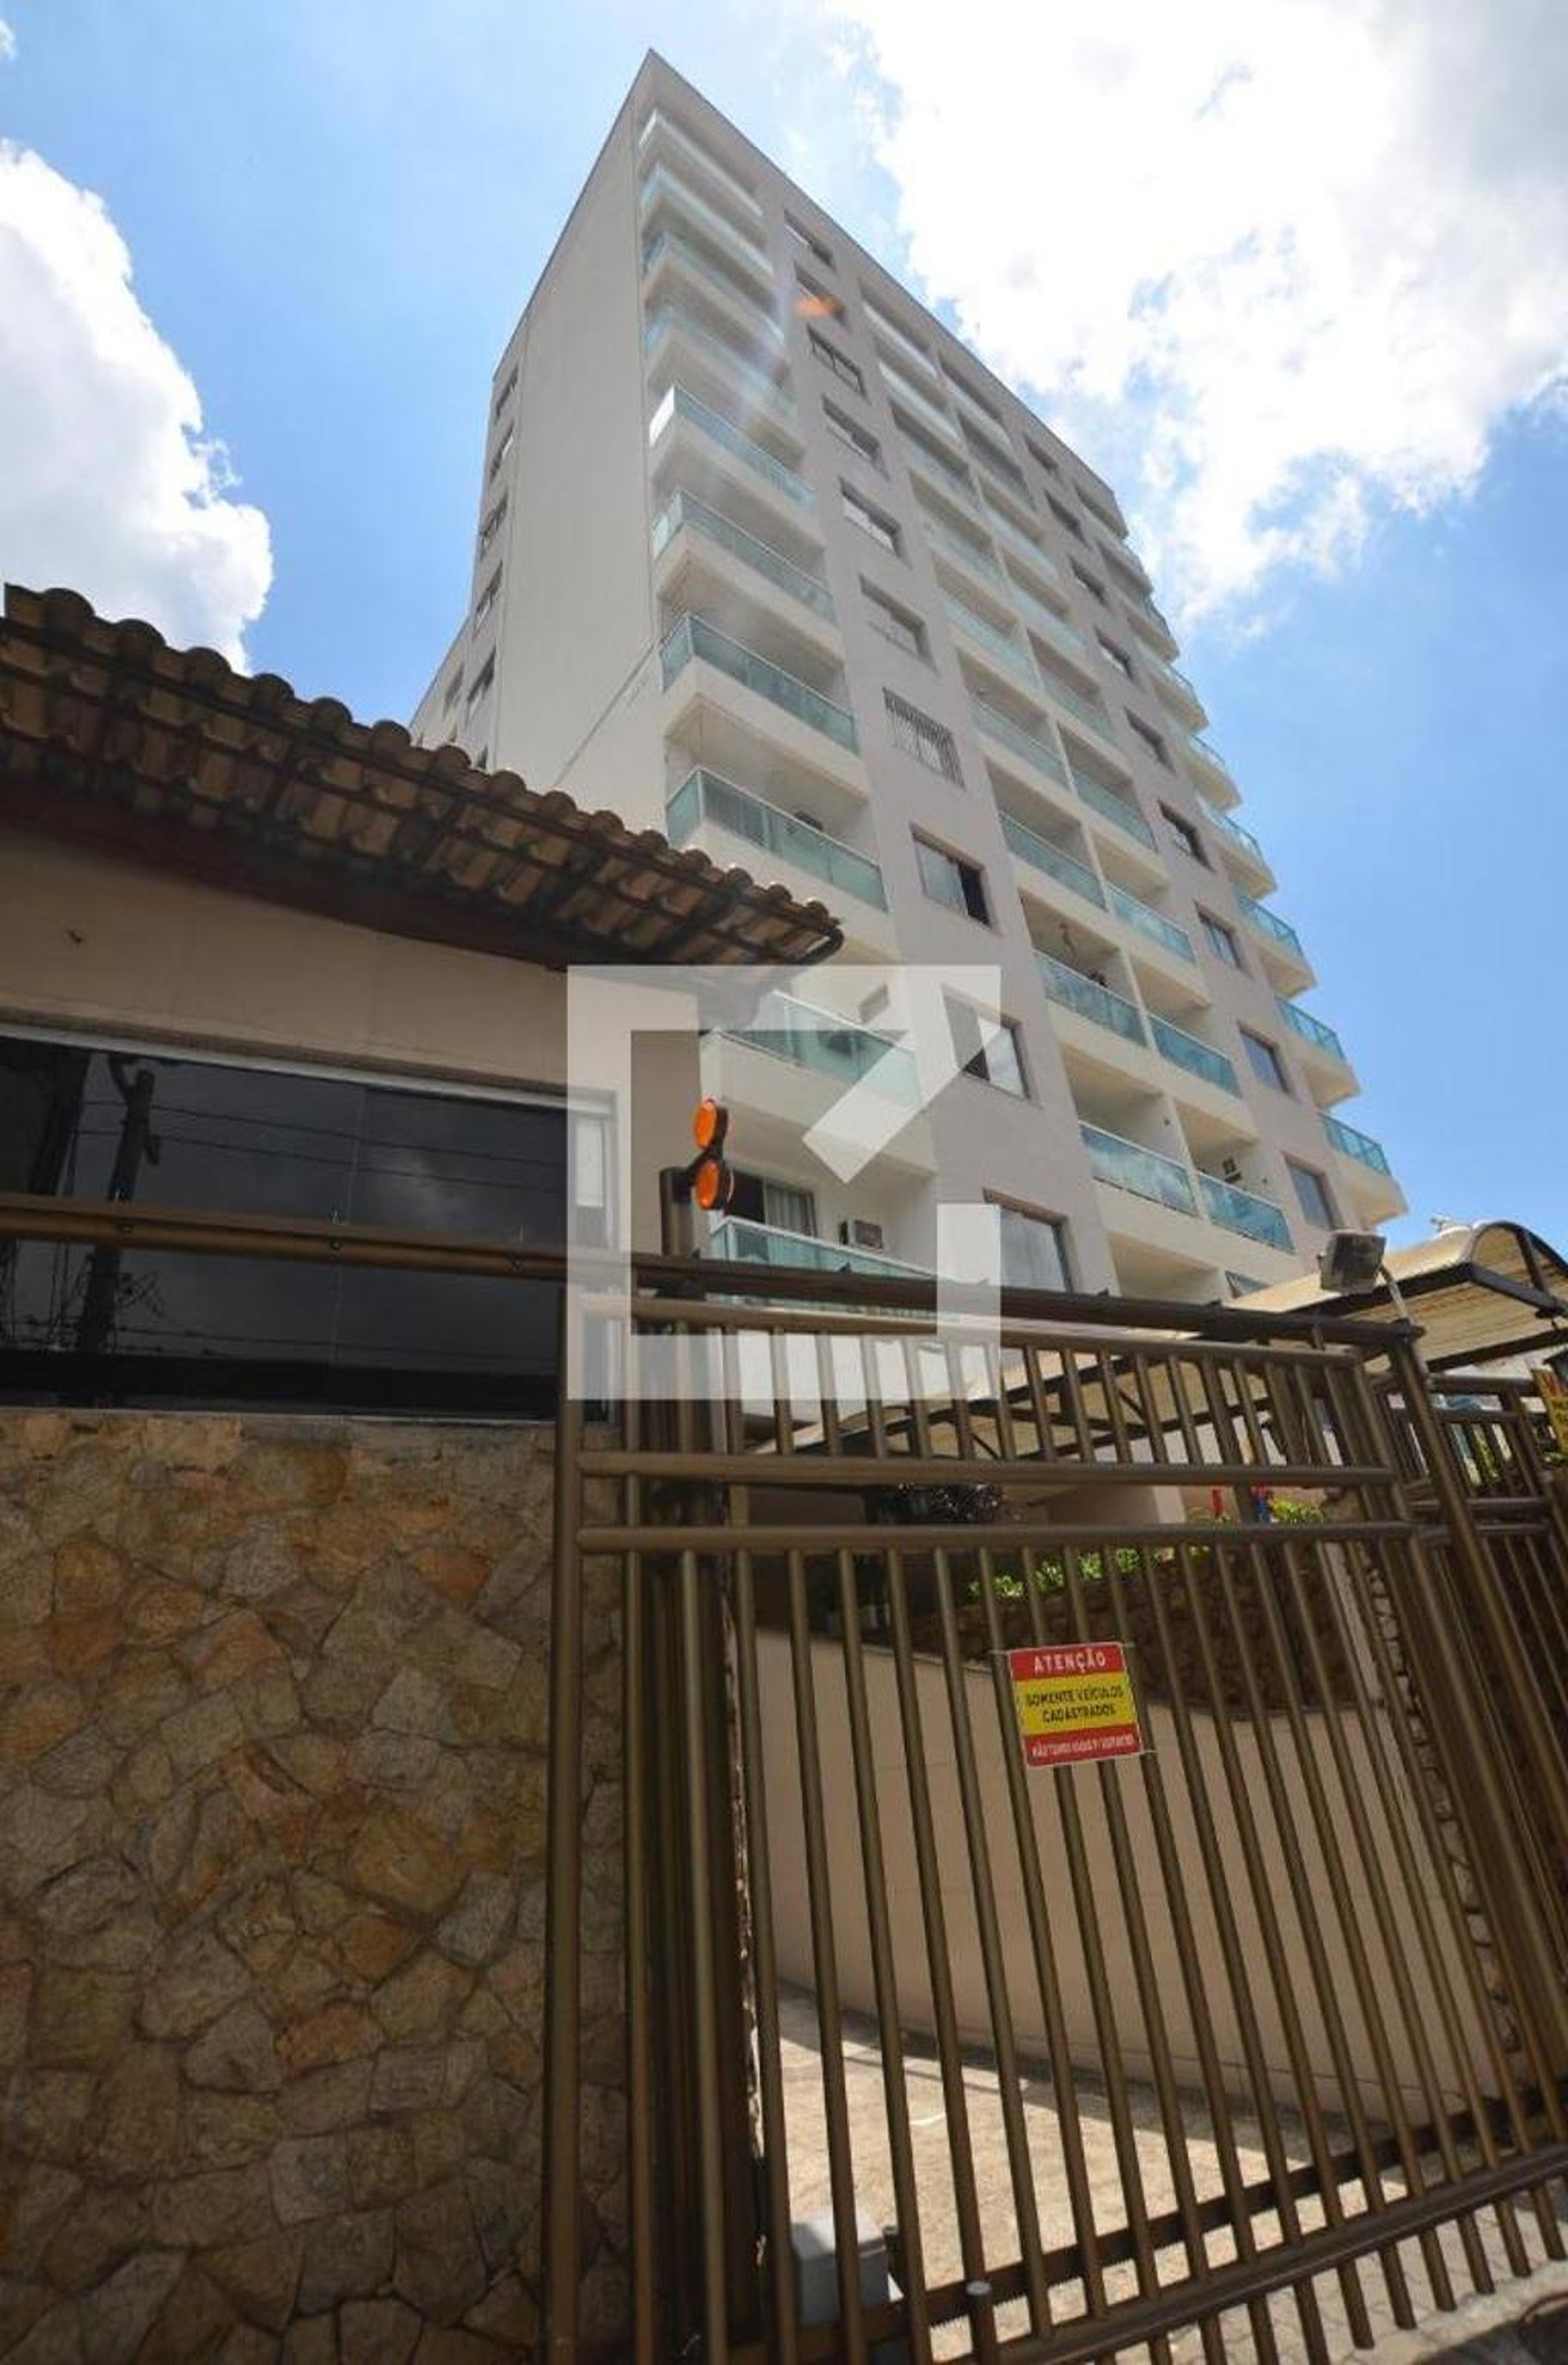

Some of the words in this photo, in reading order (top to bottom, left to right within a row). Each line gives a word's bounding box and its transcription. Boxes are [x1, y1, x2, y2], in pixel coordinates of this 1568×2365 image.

[1034, 1648, 1105, 1673] ATENÇÃO
[1026, 1690, 1073, 1707] SOMENTE
[1077, 1685, 1124, 1702] VEÍCULOS
[1043, 1703, 1116, 1722] CADASTRADOS
